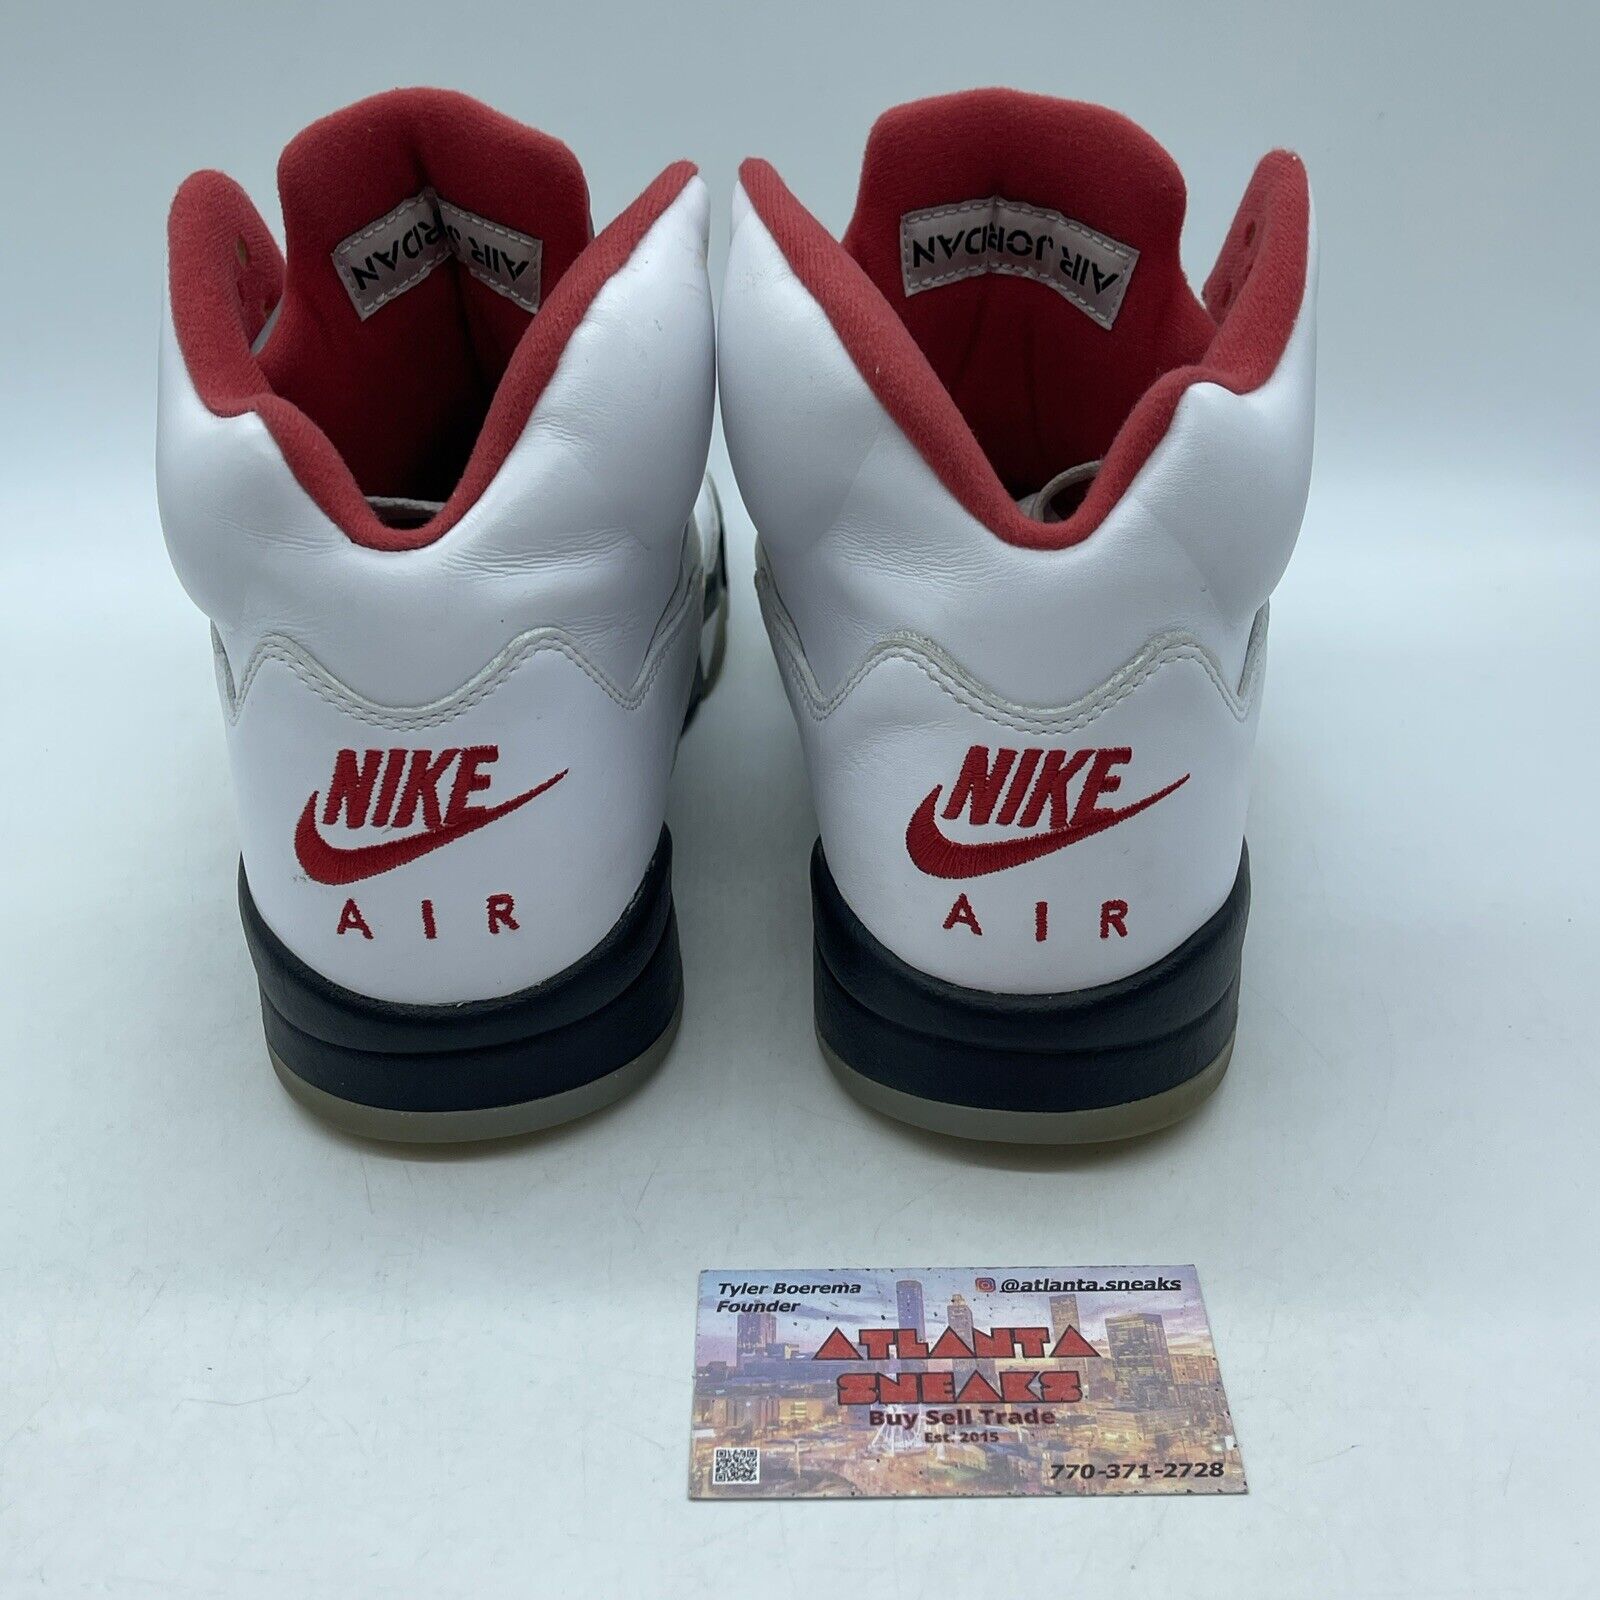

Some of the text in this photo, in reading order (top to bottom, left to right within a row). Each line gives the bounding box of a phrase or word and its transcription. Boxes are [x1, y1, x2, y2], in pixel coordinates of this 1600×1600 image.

[468, 236, 529, 281] AIR
[913, 221, 1119, 295] AIR JORDAN
[322, 745, 499, 829] NIKE
[940, 745, 1132, 829] NIKE
[336, 893, 520, 940] AIR
[942, 892, 1129, 942] AIR
[718, 1282, 862, 1298] Tyler Boerema
[1000, 1277, 1182, 1293] @atlanta.sneaks
[716, 1300, 801, 1313] Founder
[811, 1324, 1101, 1360] ATLANTA
[836, 1369, 1083, 1405] SNEAKS
[869, 1408, 1056, 1430] Buy Sell Trade
[924, 1432, 999, 1443] Est. 2015
[1050, 1462, 1225, 1479] 770-371-2728
